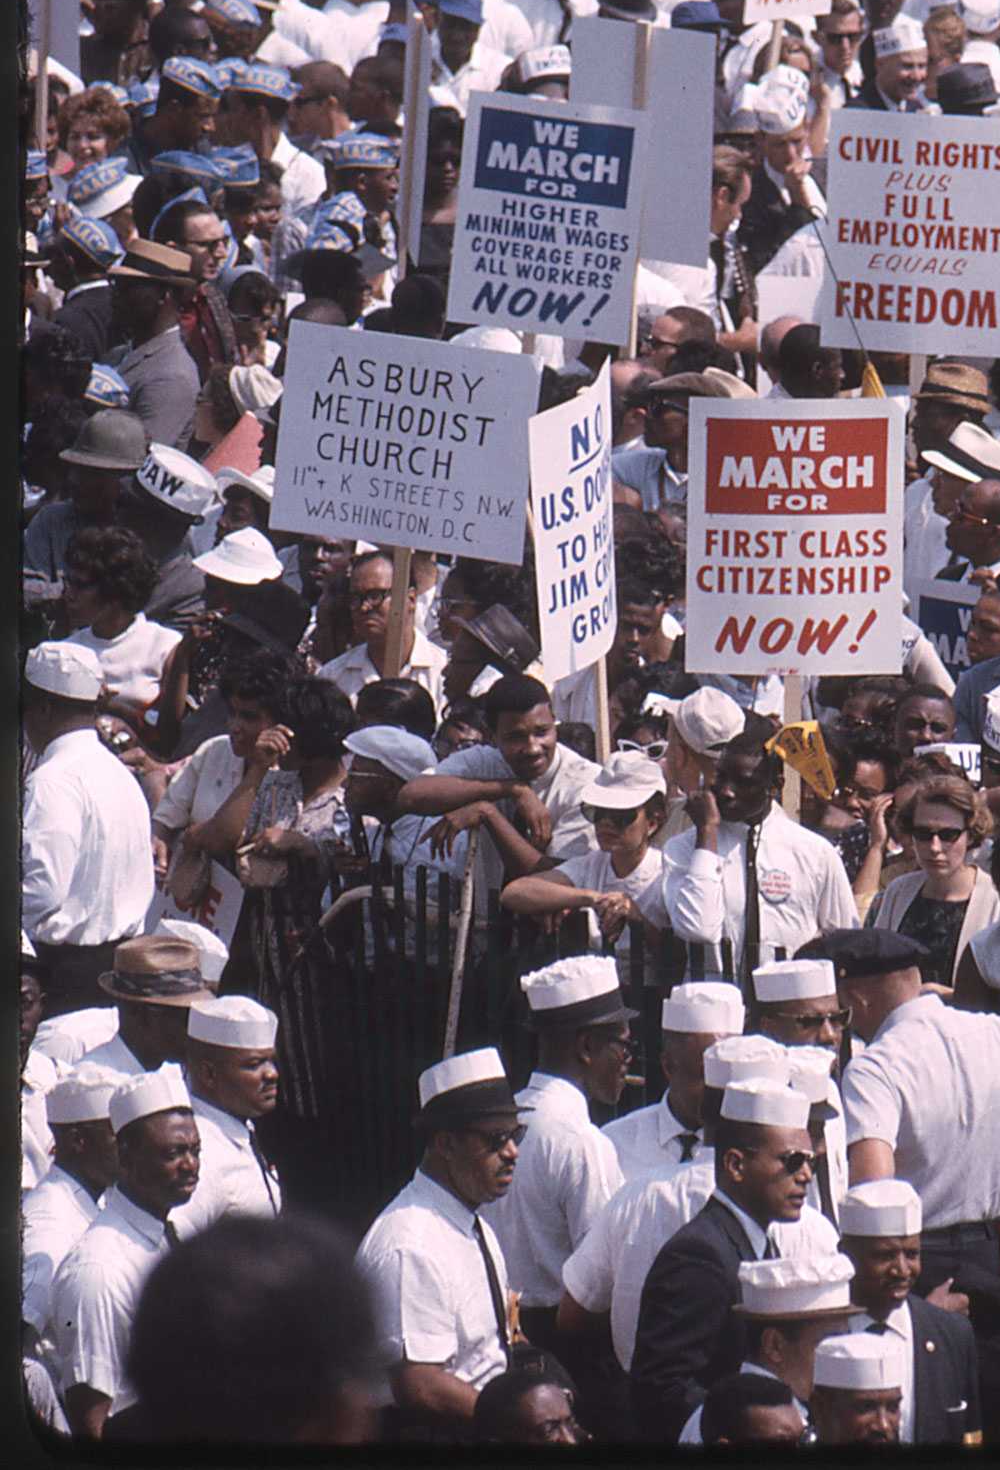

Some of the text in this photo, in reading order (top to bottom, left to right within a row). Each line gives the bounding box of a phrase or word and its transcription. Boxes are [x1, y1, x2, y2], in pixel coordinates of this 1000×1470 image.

[533, 120, 579, 149] WE
[839, 136, 903, 165] CIVIL
[487, 142, 620, 184] MARCH
[524, 178, 577, 199] FOR
[886, 171, 952, 193] PLUS
[501, 199, 599, 227] HIGHER
[884, 195, 954, 220] FULL
[465, 214, 629, 252] MINIMUM WAGES
[471, 238, 622, 272] COVERAGE FOR
[868, 252, 967, 276] EQUALS
[475, 258, 613, 290] ALL WORKERS
[471, 281, 609, 325] NOW!
[835, 282, 997, 329] FREEDOM
[328, 356, 484, 405] ASBURY
[313, 391, 495, 447] METHODIST
[772, 426, 826, 452] WE
[318, 433, 453, 480] CHURCH
[719, 456, 874, 489] MARCH
[341, 474, 352, 494] K
[370, 477, 464, 512] STREETS
[541, 487, 579, 531] U.S.
[768, 494, 828, 511] FOR
[556, 535, 587, 570] TO
[706, 530, 887, 559] FIRST CLASS
[549, 571, 588, 615] JIM
[696, 566, 891, 595] CITIZENSHIP
[715, 608, 877, 656] NOW!
